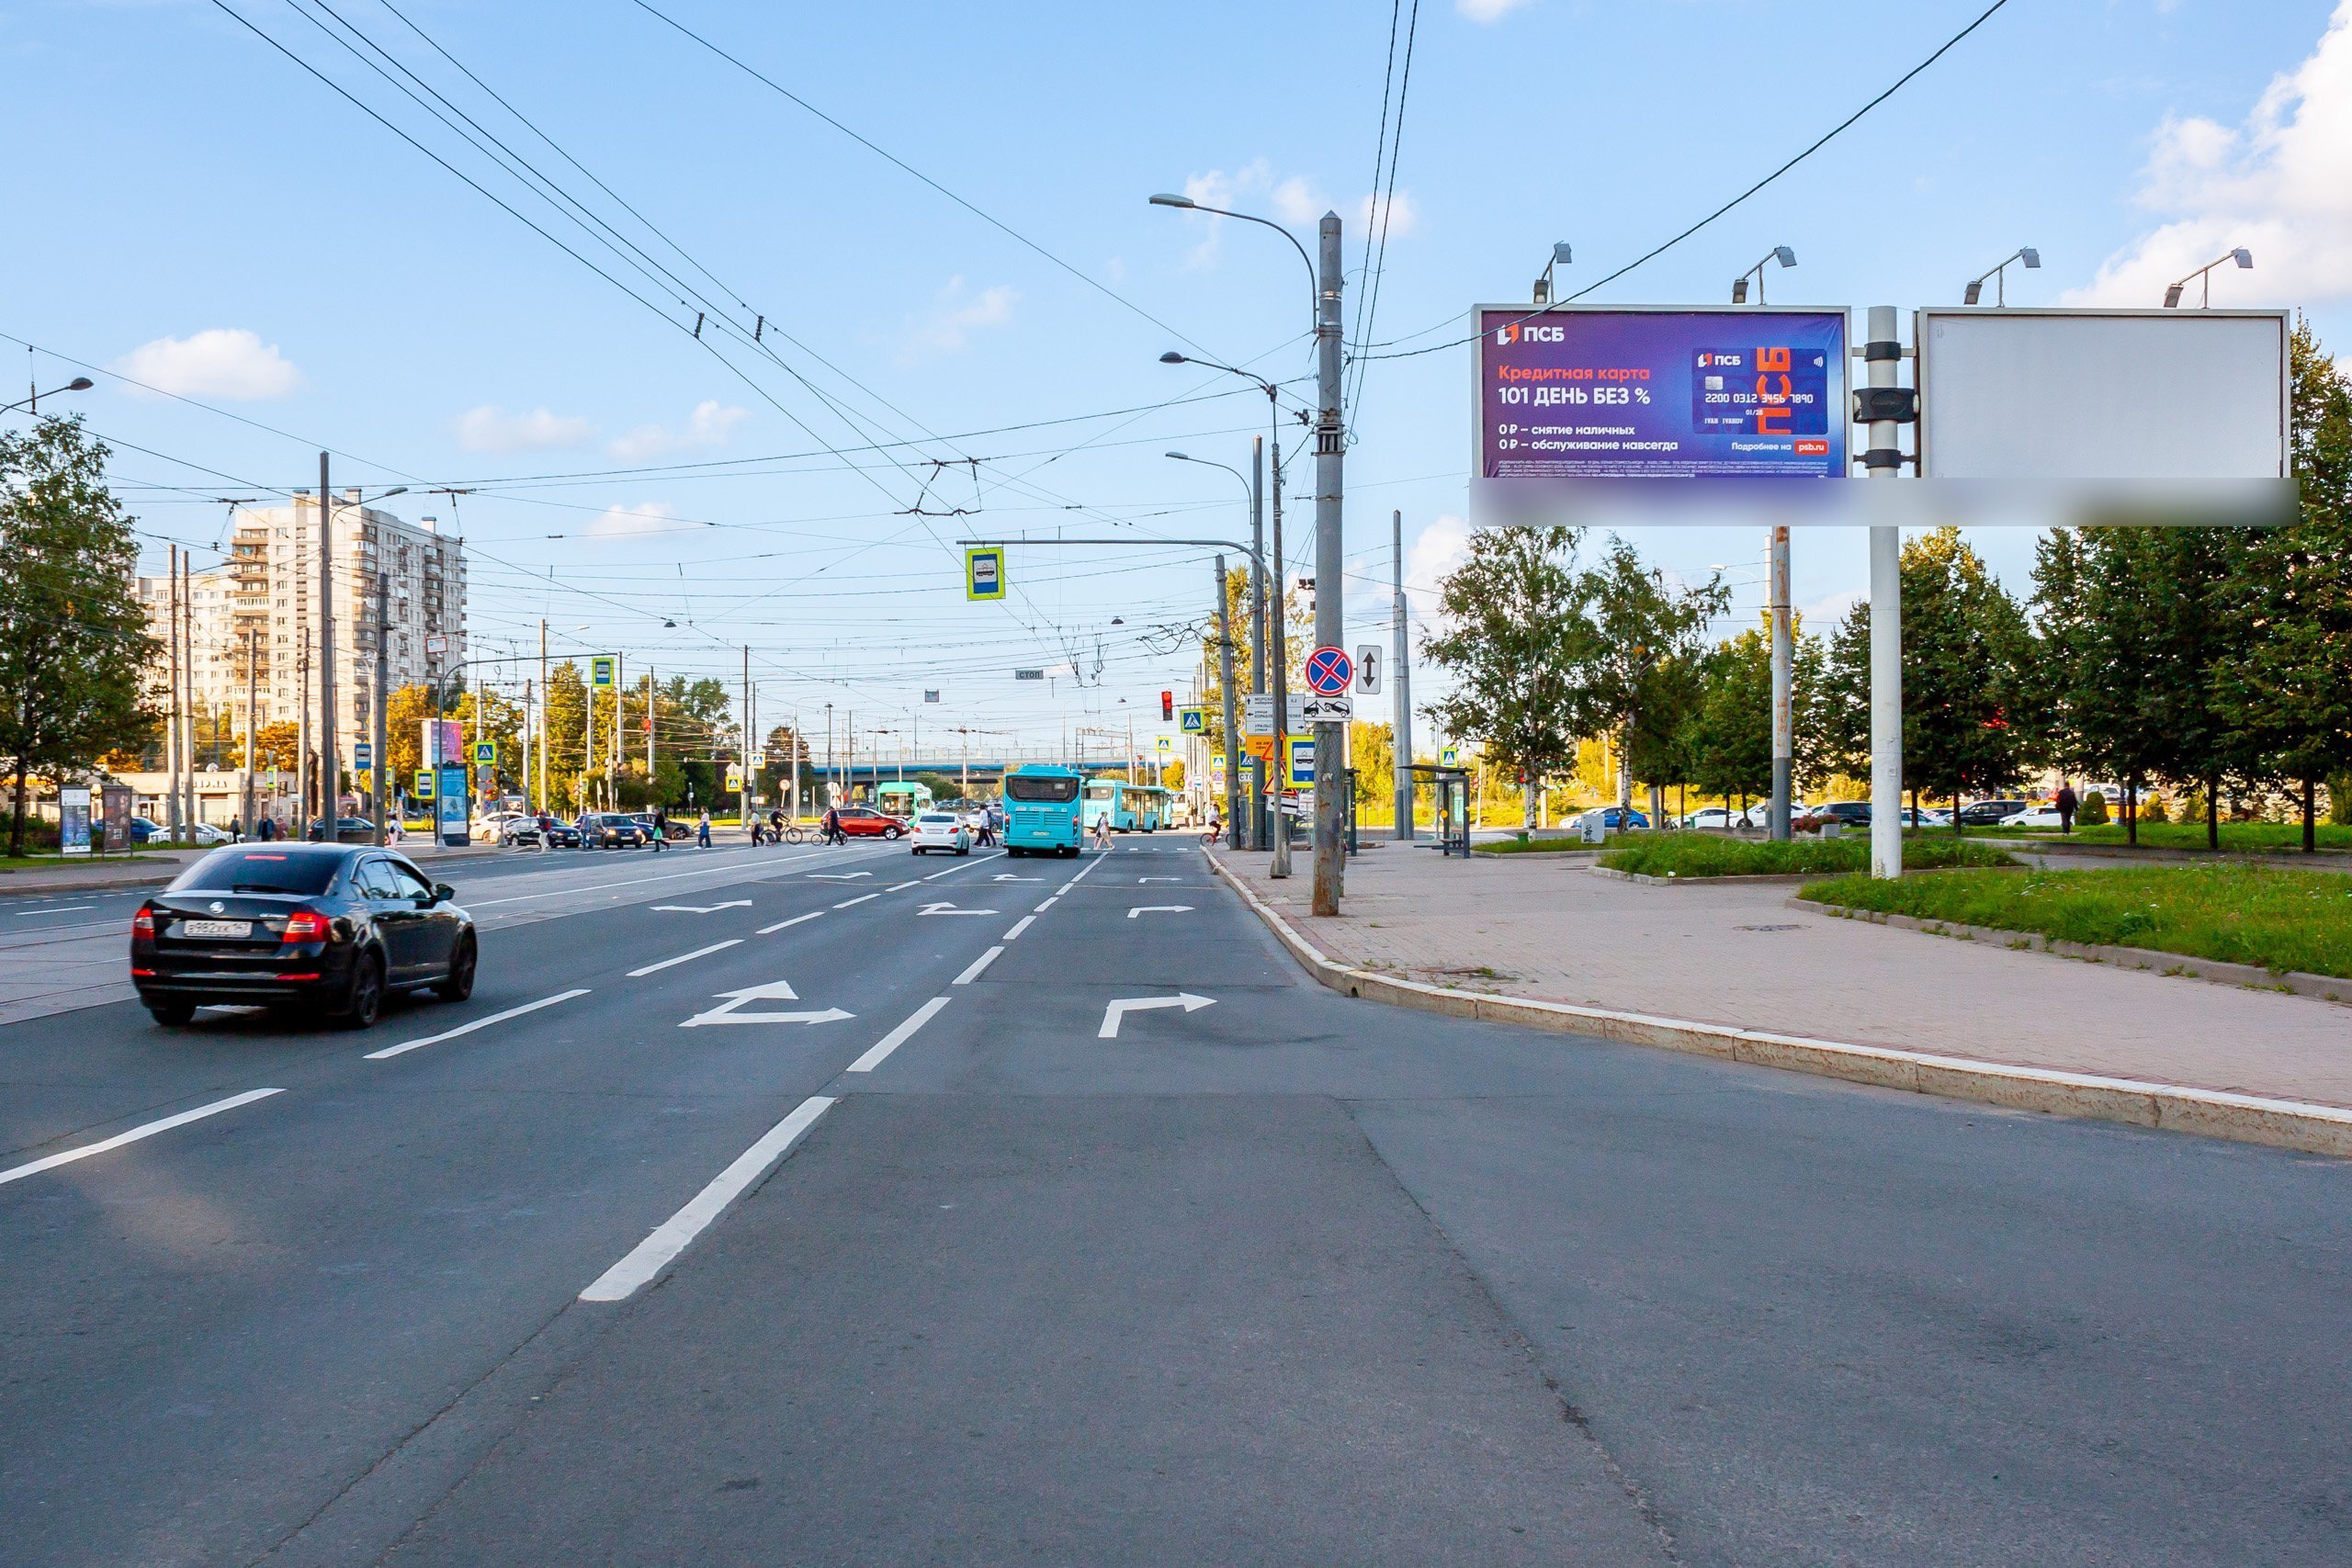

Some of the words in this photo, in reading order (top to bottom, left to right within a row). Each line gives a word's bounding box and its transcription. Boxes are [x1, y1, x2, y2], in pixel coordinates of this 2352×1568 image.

[1523, 326, 1565, 343] ПСБ
[1714, 355, 1742, 367] ПСБ
[1498, 365, 1593, 383] Кредитная
[1598, 368, 1650, 383] карта
[1498, 387, 1529, 404] 101
[1533, 387, 1589, 407] ДЕНЬ
[1593, 387, 1630, 404] БЕЗ
[1634, 388, 1651, 405] %
[1704, 393, 1730, 403] 2200
[1733, 393, 1758, 404] 0312
[1760, 393, 1786, 404] 3456
[1789, 393, 1814, 404] 7890
[1531, 424, 1573, 435] снятие
[1575, 425, 1635, 435] наличных
[1531, 439, 1620, 452] обслуживание
[1622, 441, 1679, 452] навсегда
[1731, 442, 1780, 452] Подробнее
[1798, 443, 1825, 453] psb.ru
